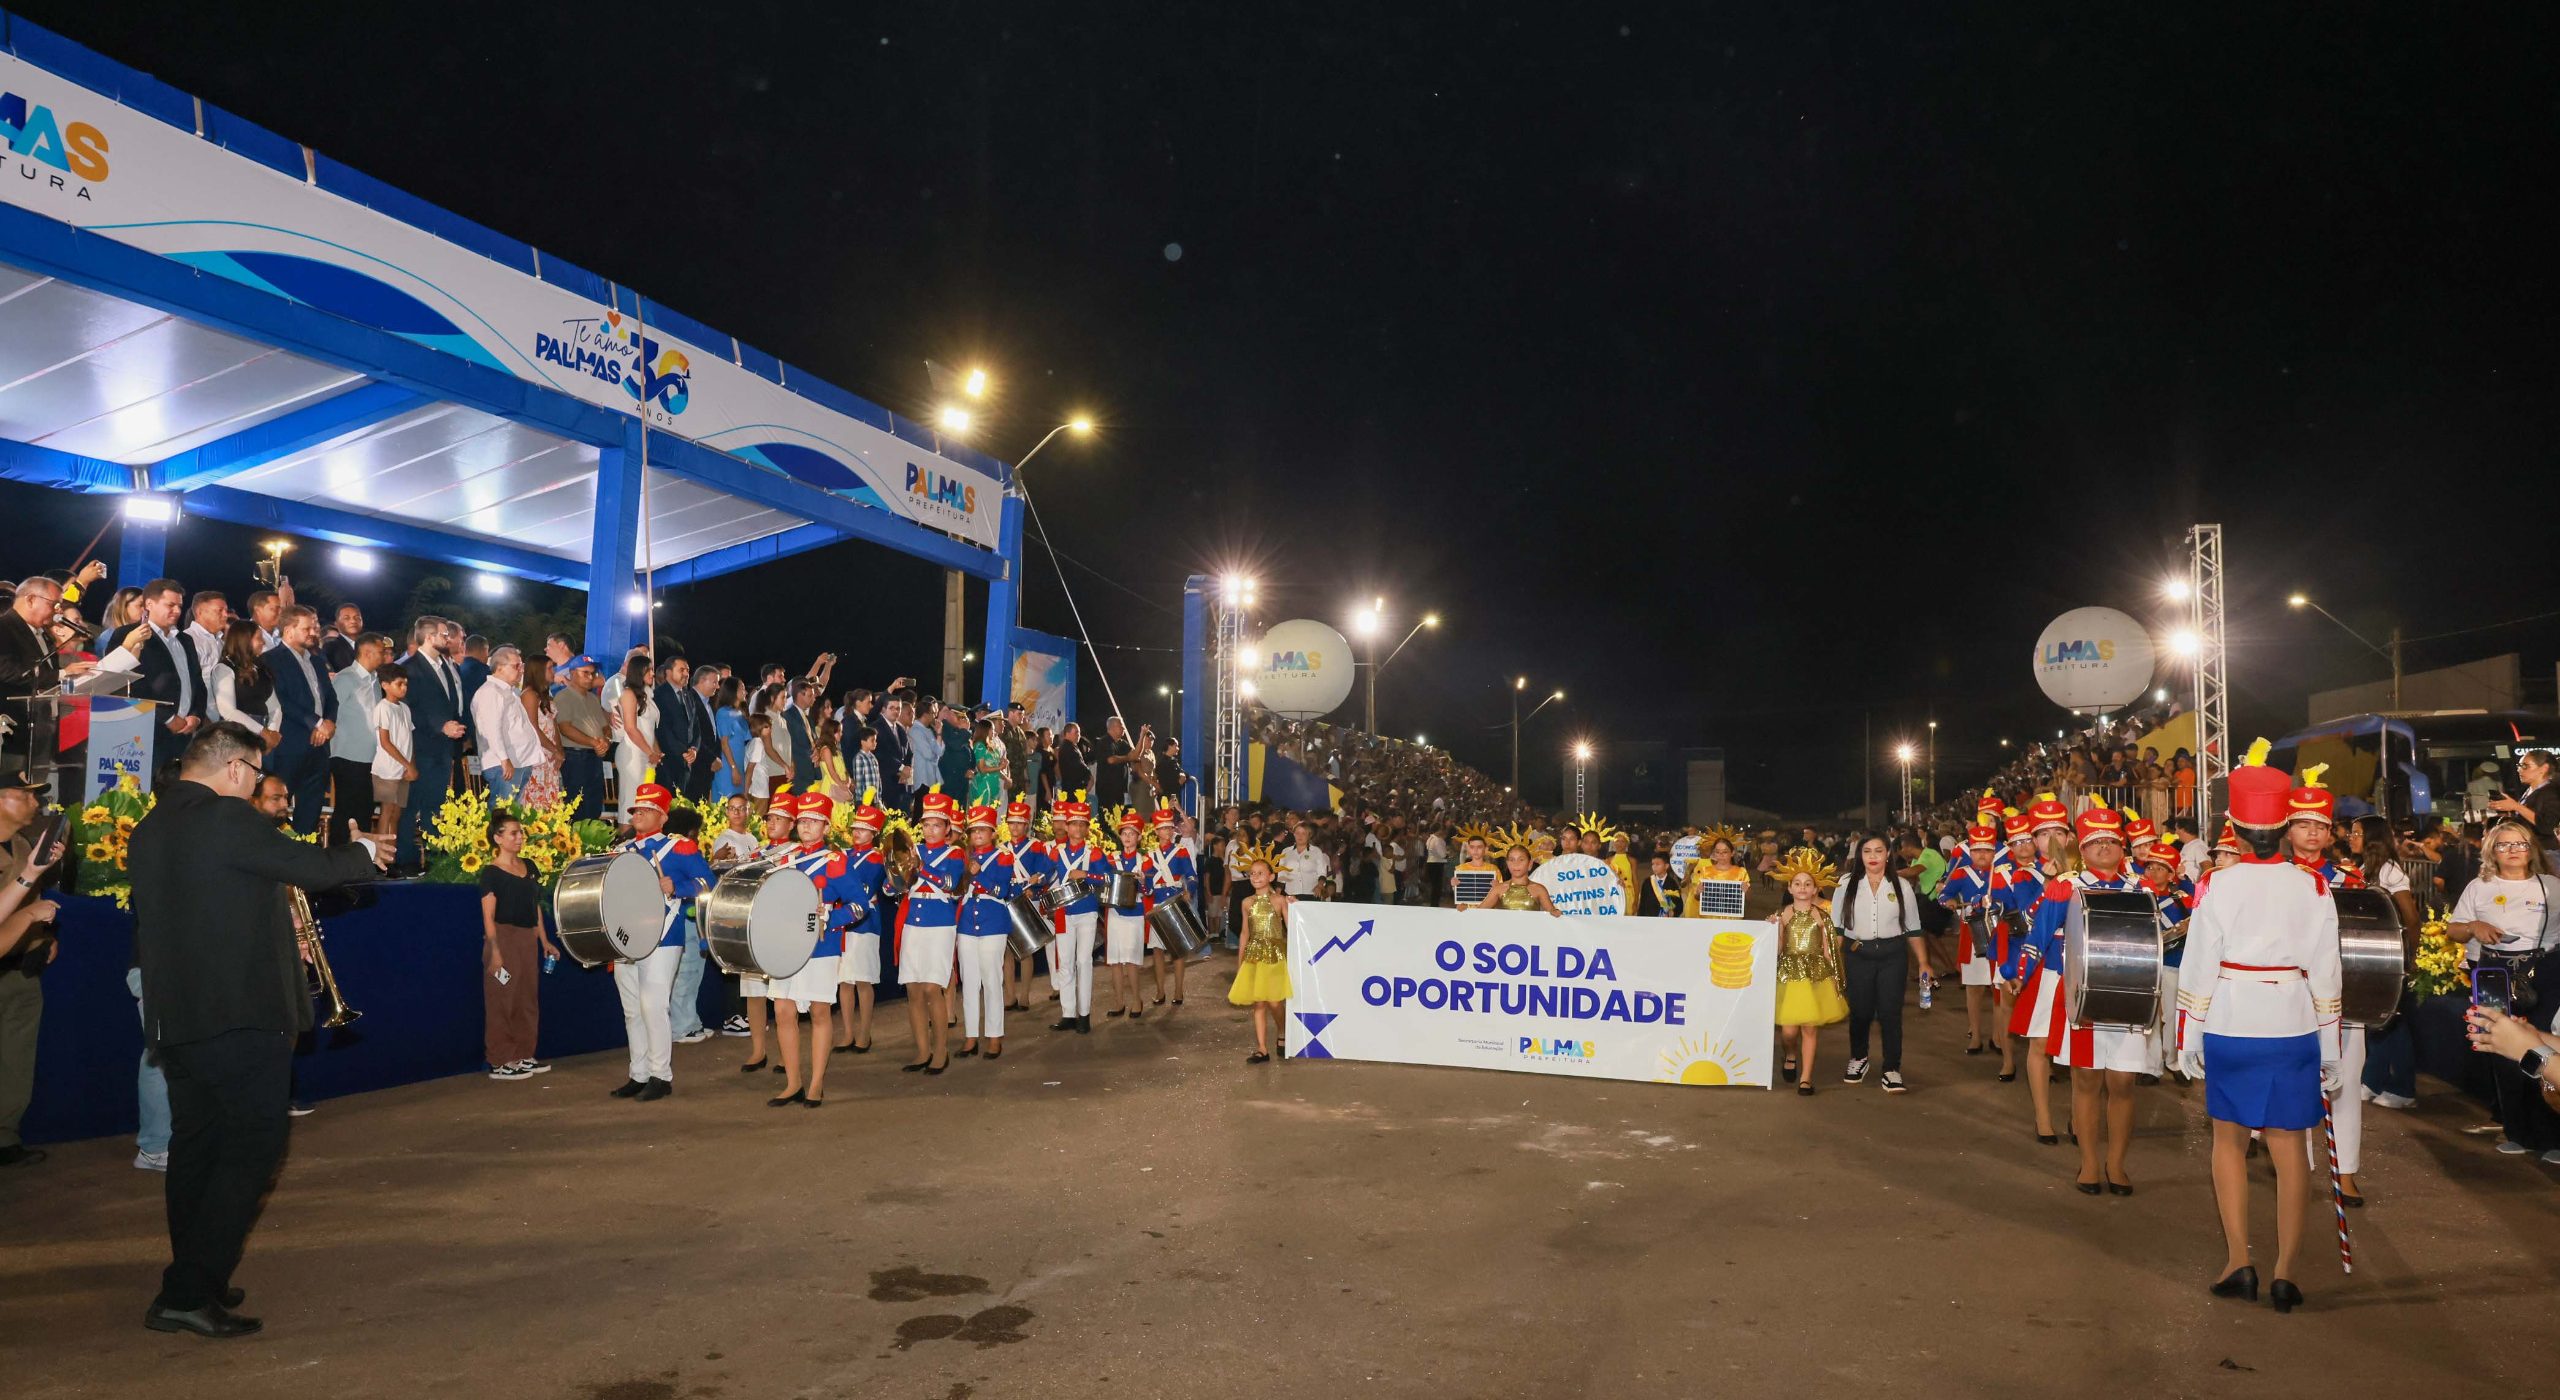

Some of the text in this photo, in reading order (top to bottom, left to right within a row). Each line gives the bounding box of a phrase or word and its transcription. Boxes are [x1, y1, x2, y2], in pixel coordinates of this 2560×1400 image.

[563, 318, 634, 360] Te amo
[535, 332, 621, 385] PALMAS
[636, 403, 673, 426] ANOS
[906, 462, 976, 514] PALMAS
[909, 496, 971, 524] PREFEITURA
[1557, 866, 1608, 881] SOL DO
[1610, 887, 1620, 896] A
[1599, 905, 1618, 915] DA
[807, 912, 816, 933] BM
[615, 926, 629, 946] BM
[1435, 940, 1617, 981] O SOL DA
[1361, 975, 1687, 1026] OPORTUNIDADE
[1520, 1036, 1596, 1059] PALMAS
[1523, 1055, 1591, 1064] PREFEITURA
